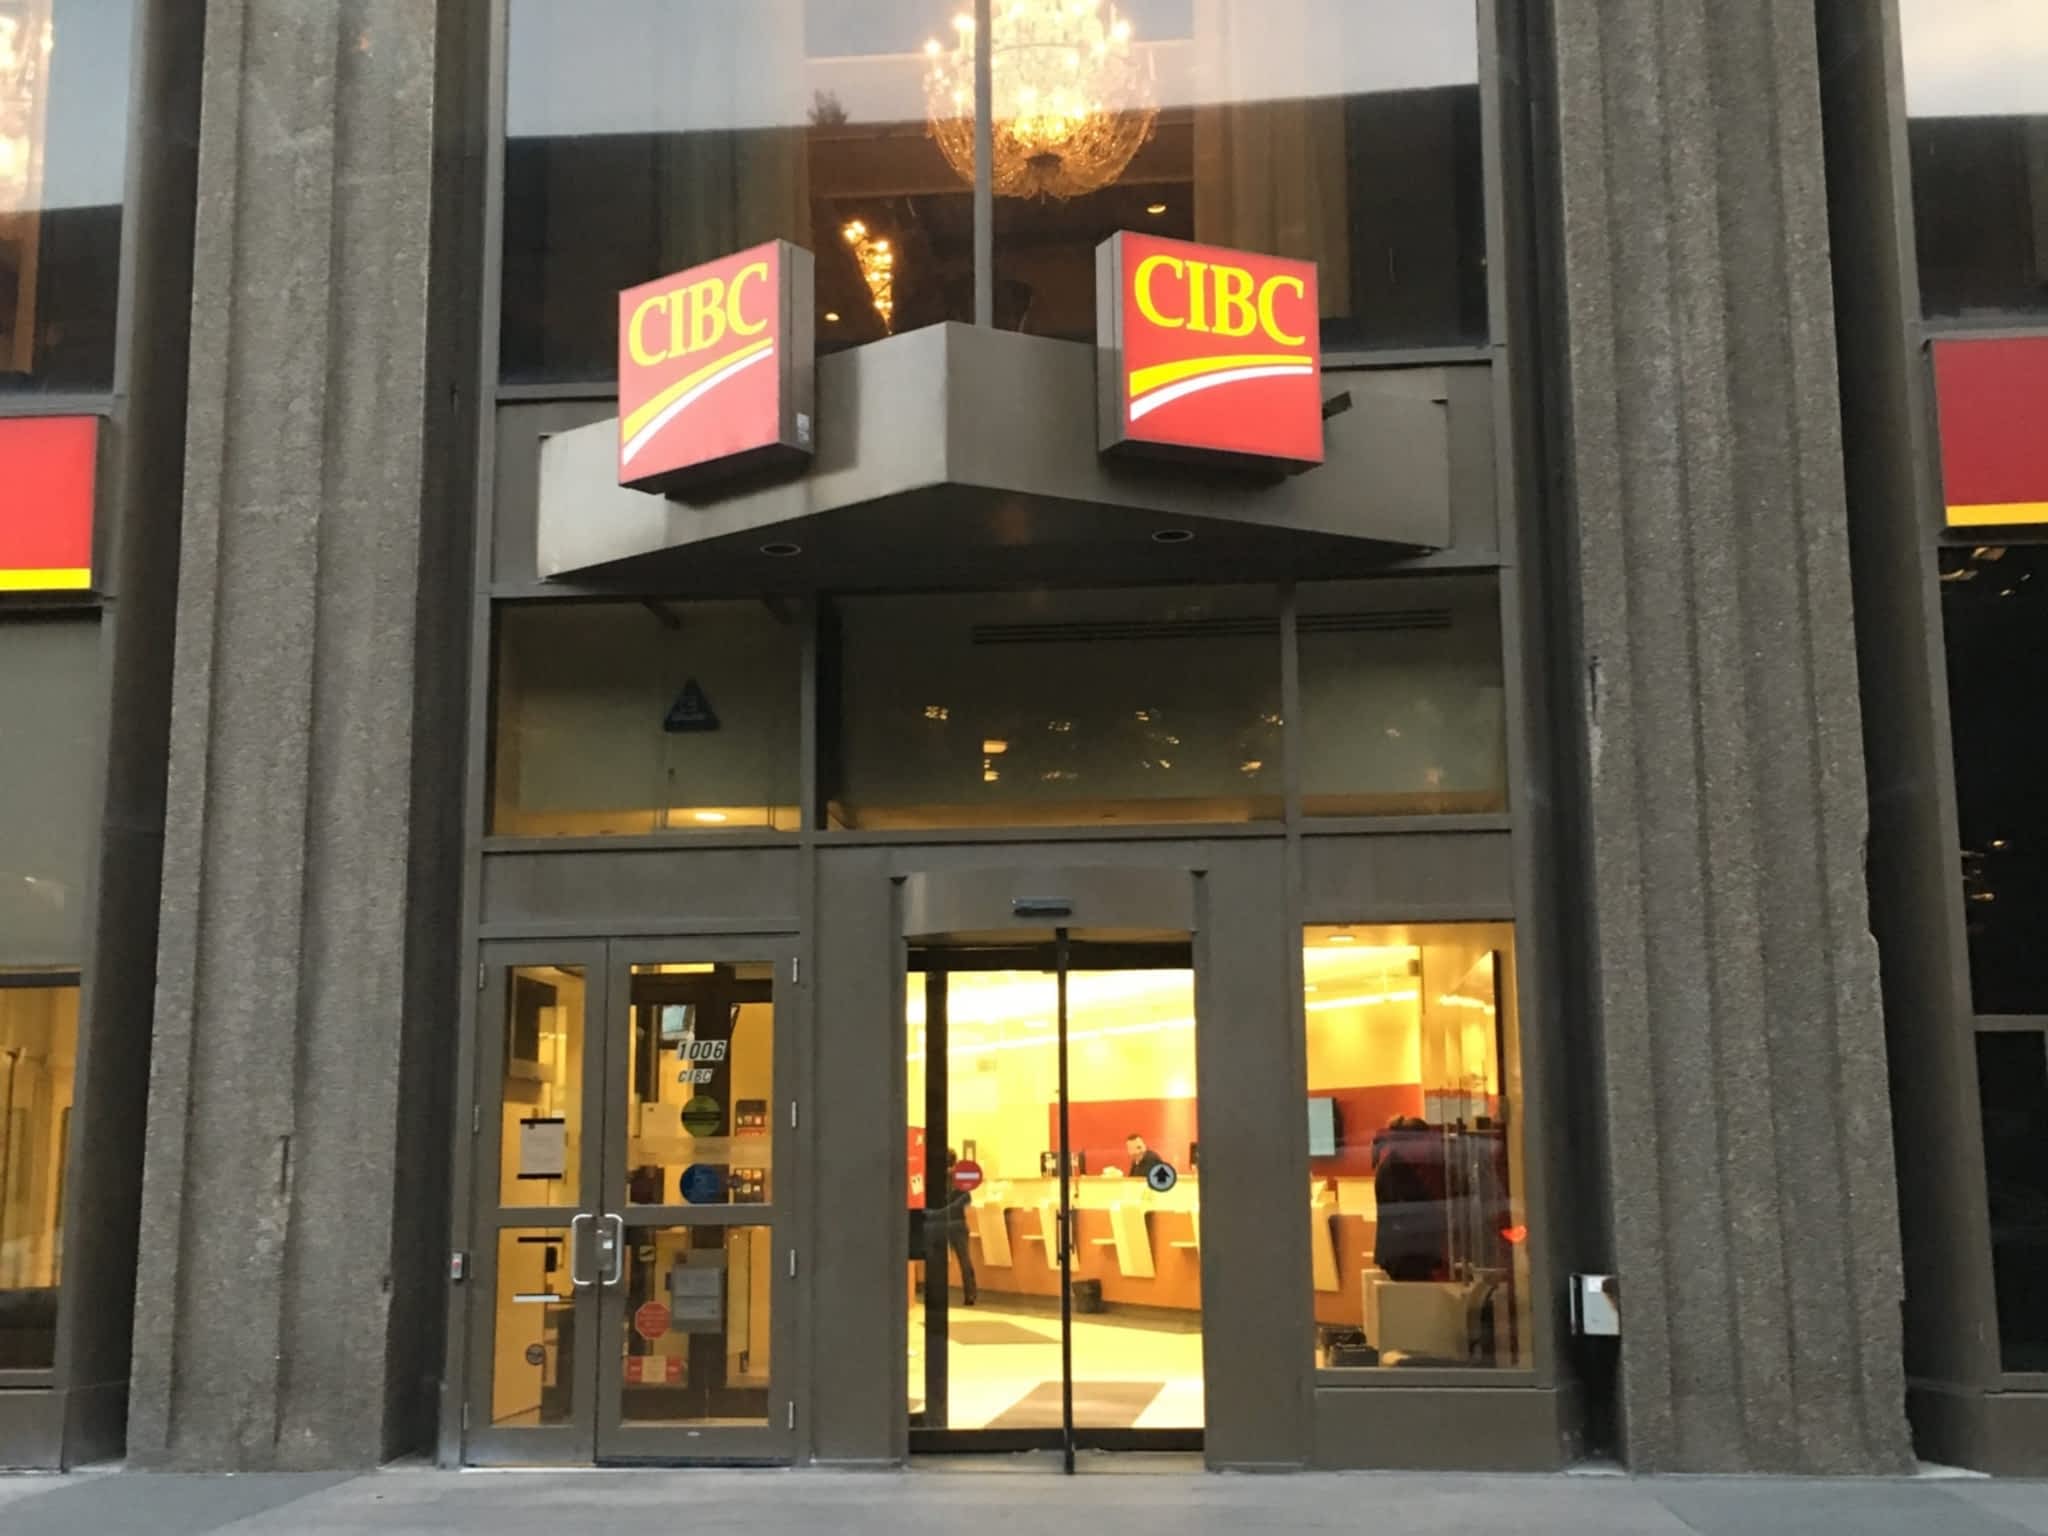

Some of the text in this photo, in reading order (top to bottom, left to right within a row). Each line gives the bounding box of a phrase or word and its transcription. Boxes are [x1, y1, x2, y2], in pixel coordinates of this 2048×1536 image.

[627, 262, 769, 366] CIBC
[1134, 255, 1306, 346] CIBC
[678, 1070, 712, 1082] CIBC
[679, 1041, 725, 1060] 1006
